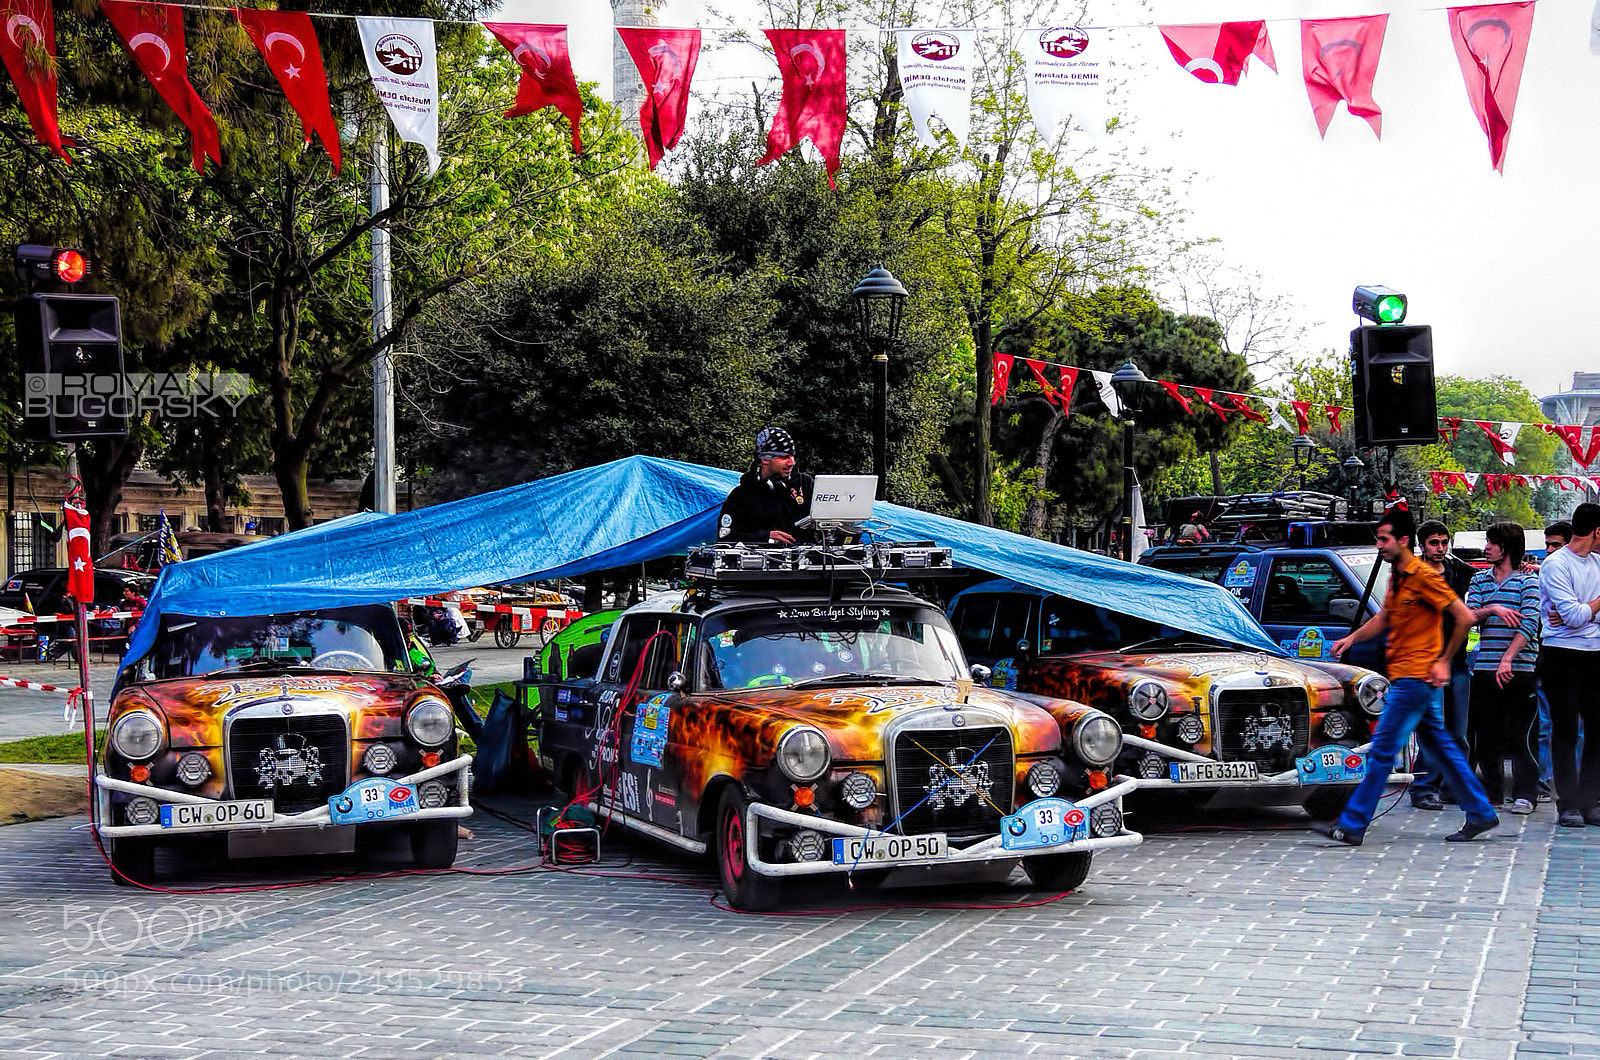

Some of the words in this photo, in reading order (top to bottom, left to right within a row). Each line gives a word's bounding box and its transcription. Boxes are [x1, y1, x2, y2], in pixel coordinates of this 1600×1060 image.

[789, 608, 810, 618] Low
[811, 606, 845, 620] Budget
[846, 606, 880, 620] Styling
[1323, 753, 1335, 766] 33
[1180, 764, 1189, 780] M
[1196, 764, 1213, 779] FG
[1216, 763, 1257, 779] 3312H
[364, 788, 379, 802] 33
[178, 806, 202, 824] CW
[216, 804, 239, 822] OP
[243, 803, 266, 820] 60
[1039, 809, 1053, 825] 33
[850, 840, 875, 860] CW
[888, 839, 912, 858] OP
[916, 837, 939, 856] 50
